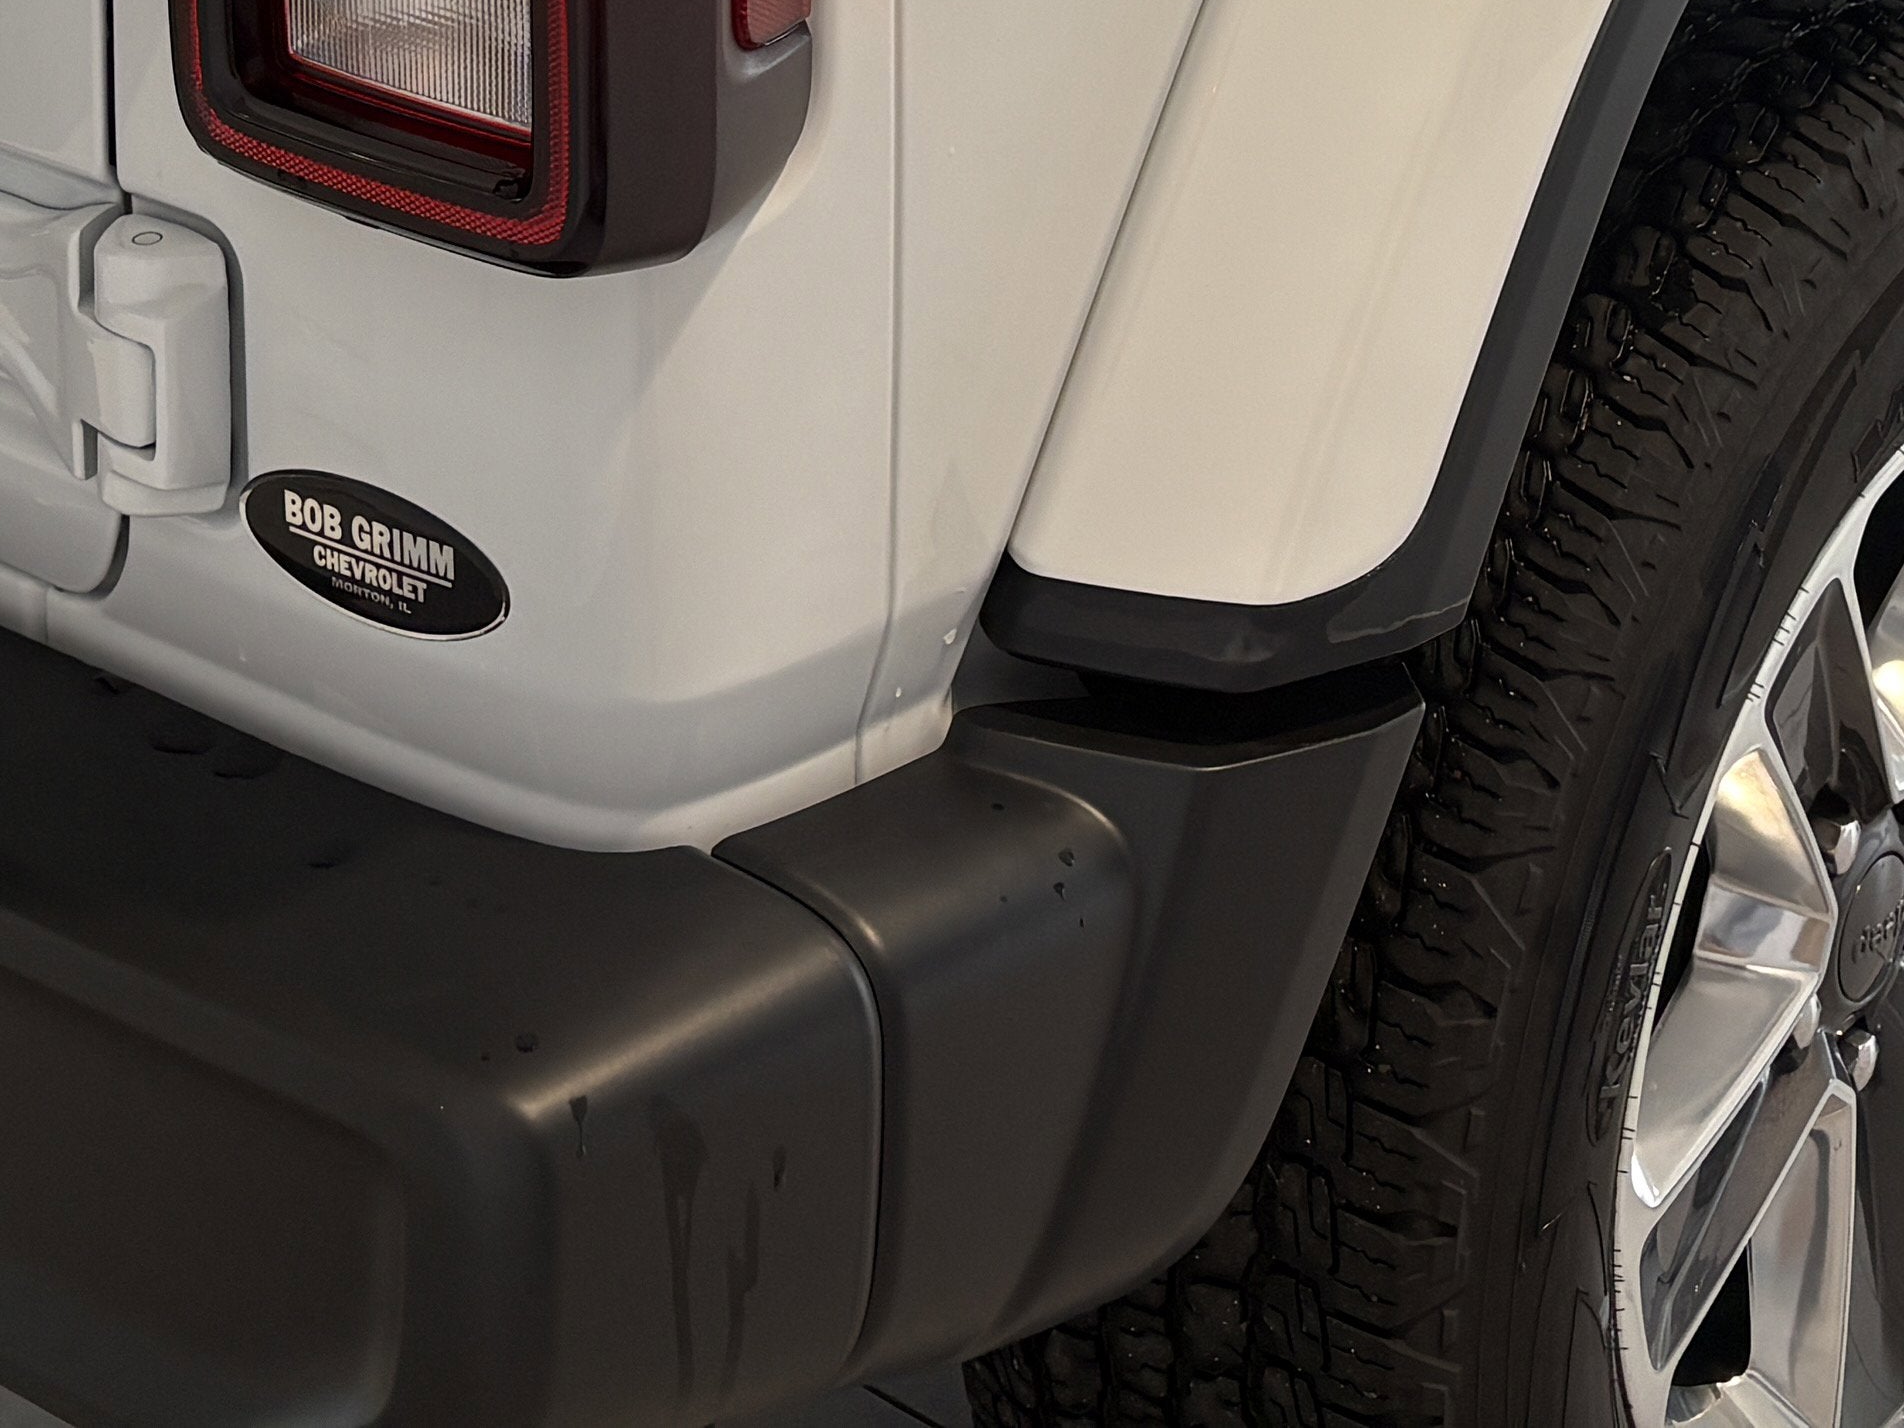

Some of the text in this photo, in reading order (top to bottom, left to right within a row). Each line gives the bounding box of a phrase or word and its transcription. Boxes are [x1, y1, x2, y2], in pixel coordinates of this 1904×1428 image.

[284, 489, 455, 581] BOB GRIMM
[313, 545, 428, 603] CHEVROLET
[398, 600, 412, 614] IL
